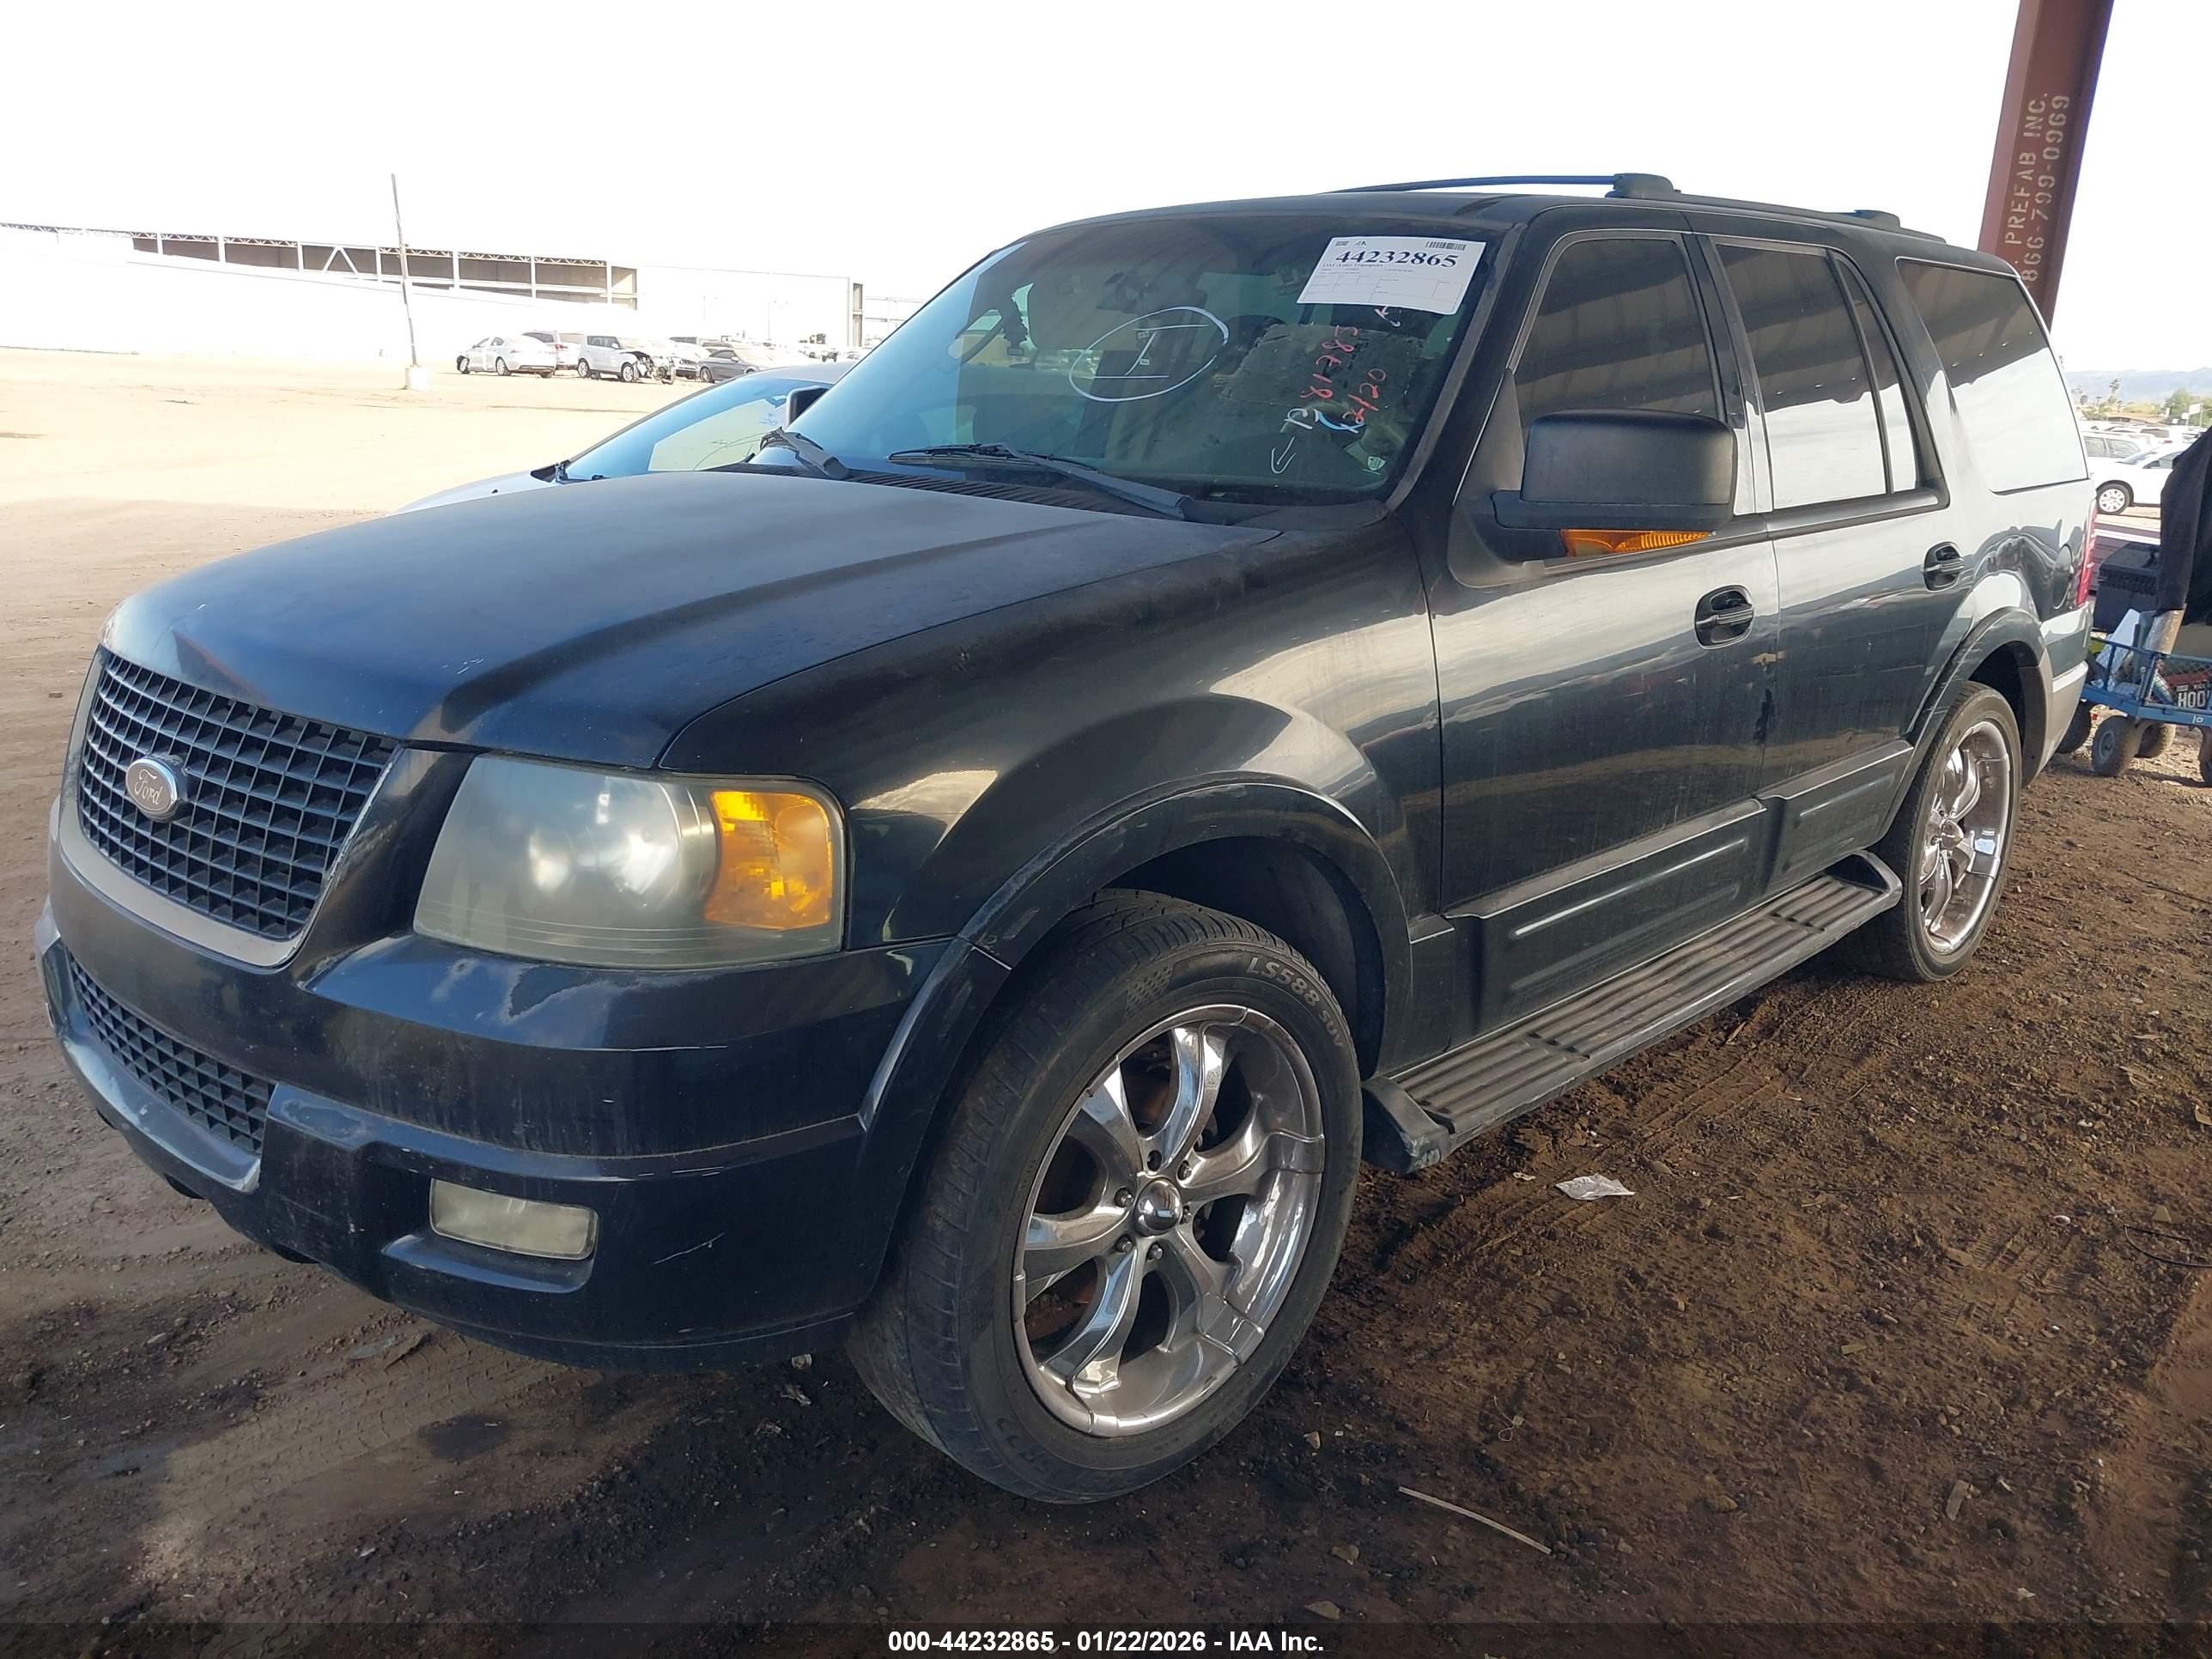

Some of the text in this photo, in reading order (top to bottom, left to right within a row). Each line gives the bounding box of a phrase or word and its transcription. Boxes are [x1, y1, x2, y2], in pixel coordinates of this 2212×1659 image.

[2004, 92, 2049, 245] PREFAB INC.
[1334, 250, 1460, 268] 44232865
[134, 769, 164, 805] Ford
[1245, 956, 1346, 1048] LS588 SUV
